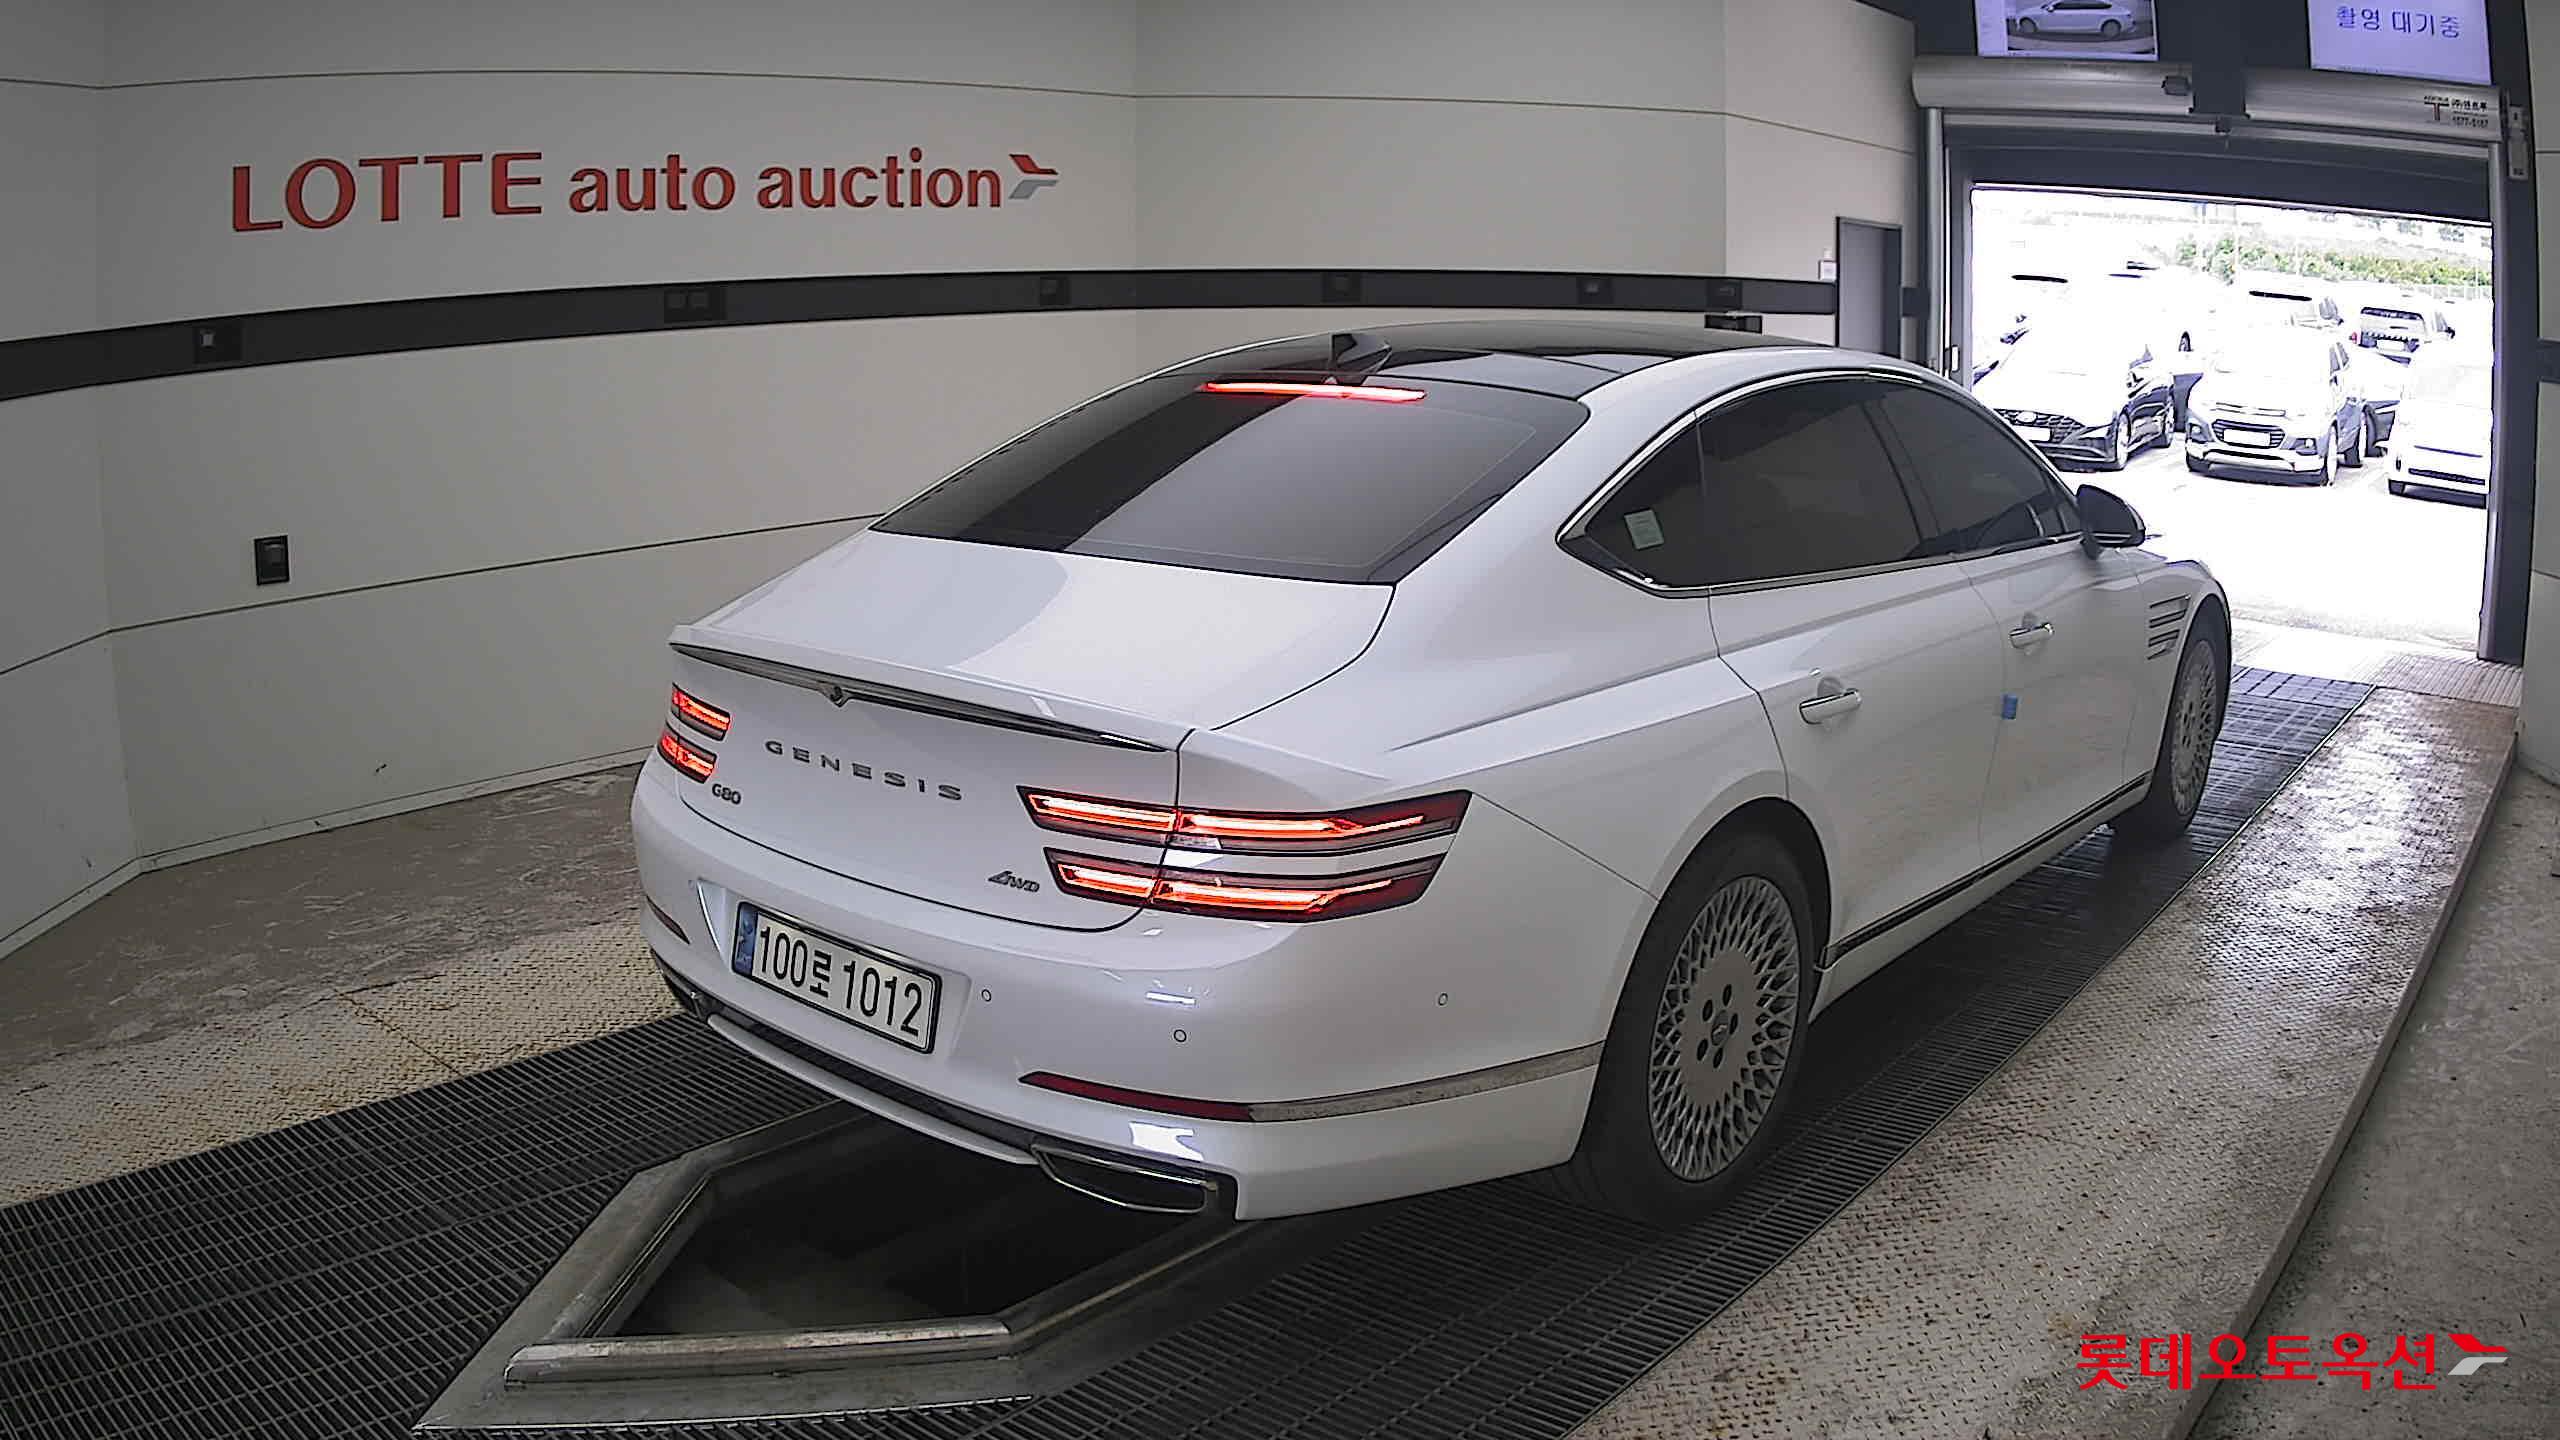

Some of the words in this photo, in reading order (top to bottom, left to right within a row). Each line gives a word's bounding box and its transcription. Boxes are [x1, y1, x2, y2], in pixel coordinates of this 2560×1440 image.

[2337, 5, 2380, 31] 촬영
[2391, 11, 2460, 39] 대기중
[232, 151, 543, 233] LOTTE
[568, 153, 736, 213] auto
[757, 147, 1001, 209] auction
[711, 783, 742, 805] G80
[765, 740, 963, 802] GENESIS
[843, 961, 922, 1037] 1012
